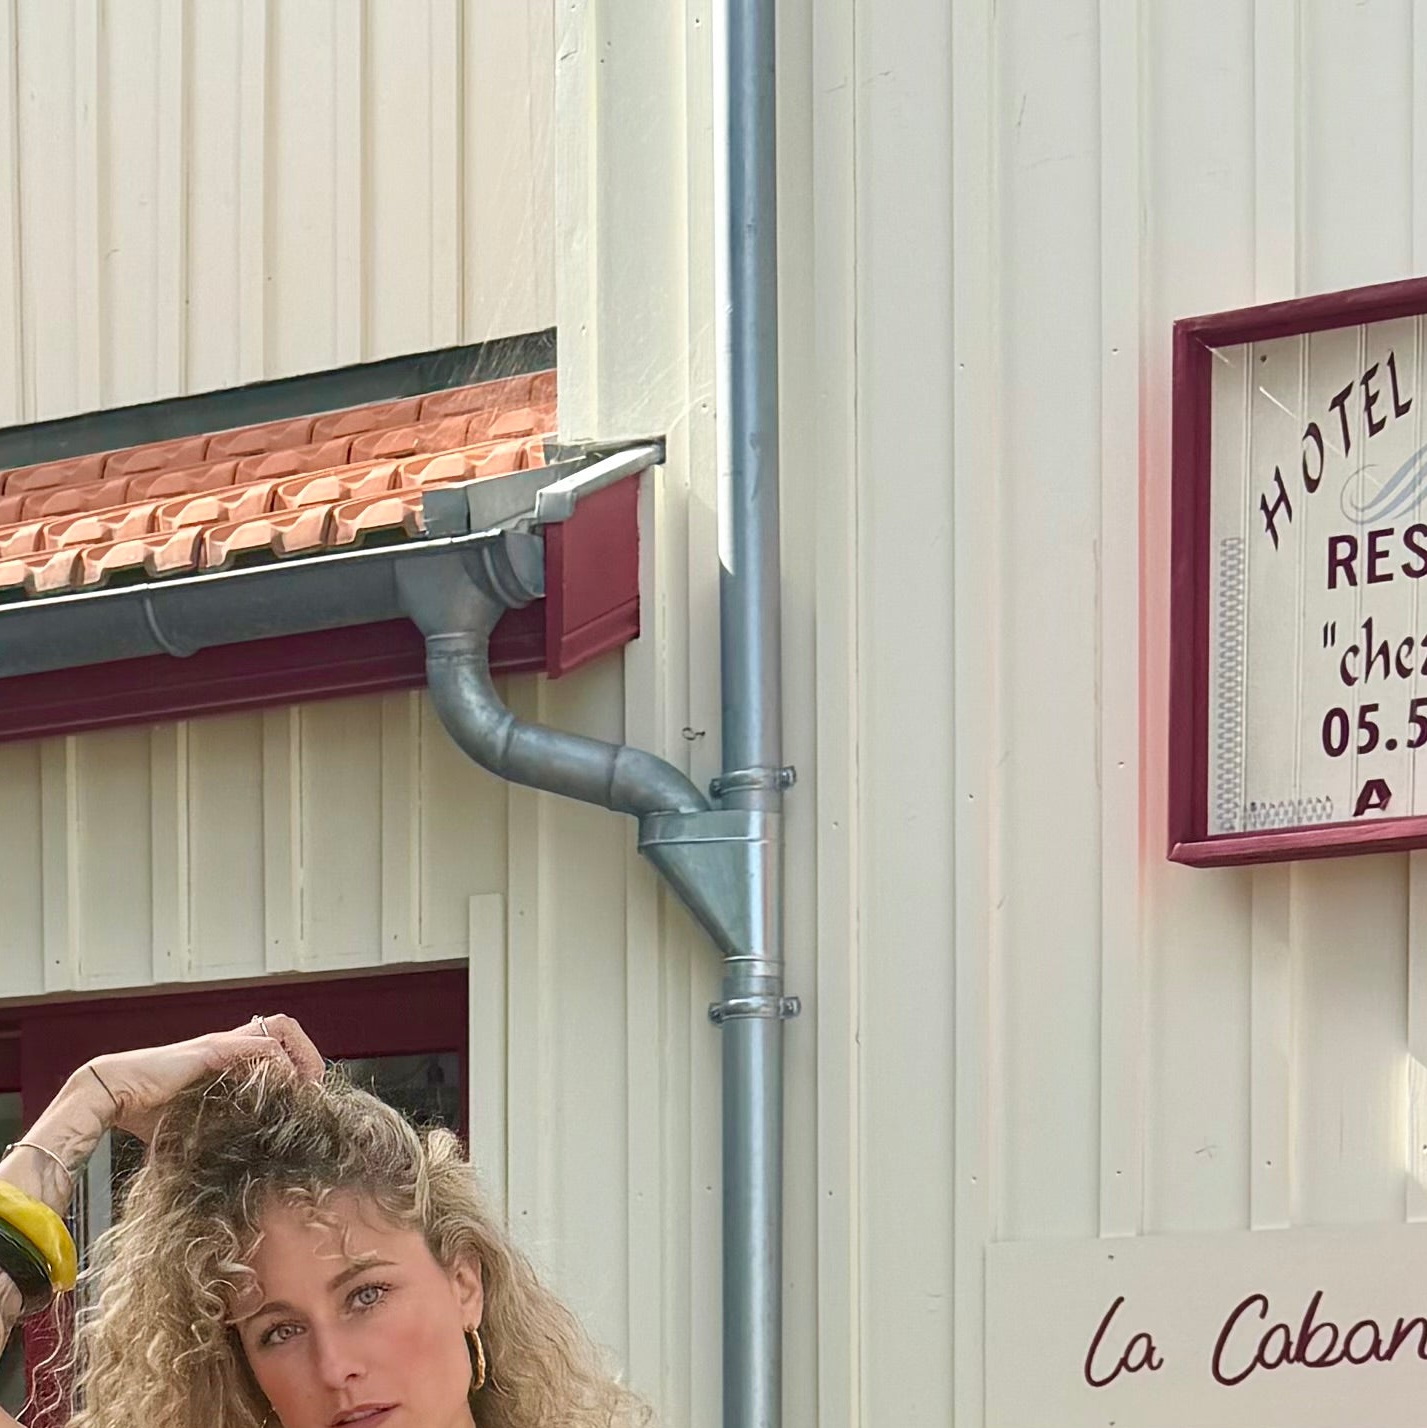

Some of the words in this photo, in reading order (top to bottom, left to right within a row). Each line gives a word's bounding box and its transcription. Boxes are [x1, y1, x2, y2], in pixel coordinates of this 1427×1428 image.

[1260, 351, 1412, 549] HOTEL
[1352, 778, 1393, 818] A
[1084, 1296, 1164, 1388] La
